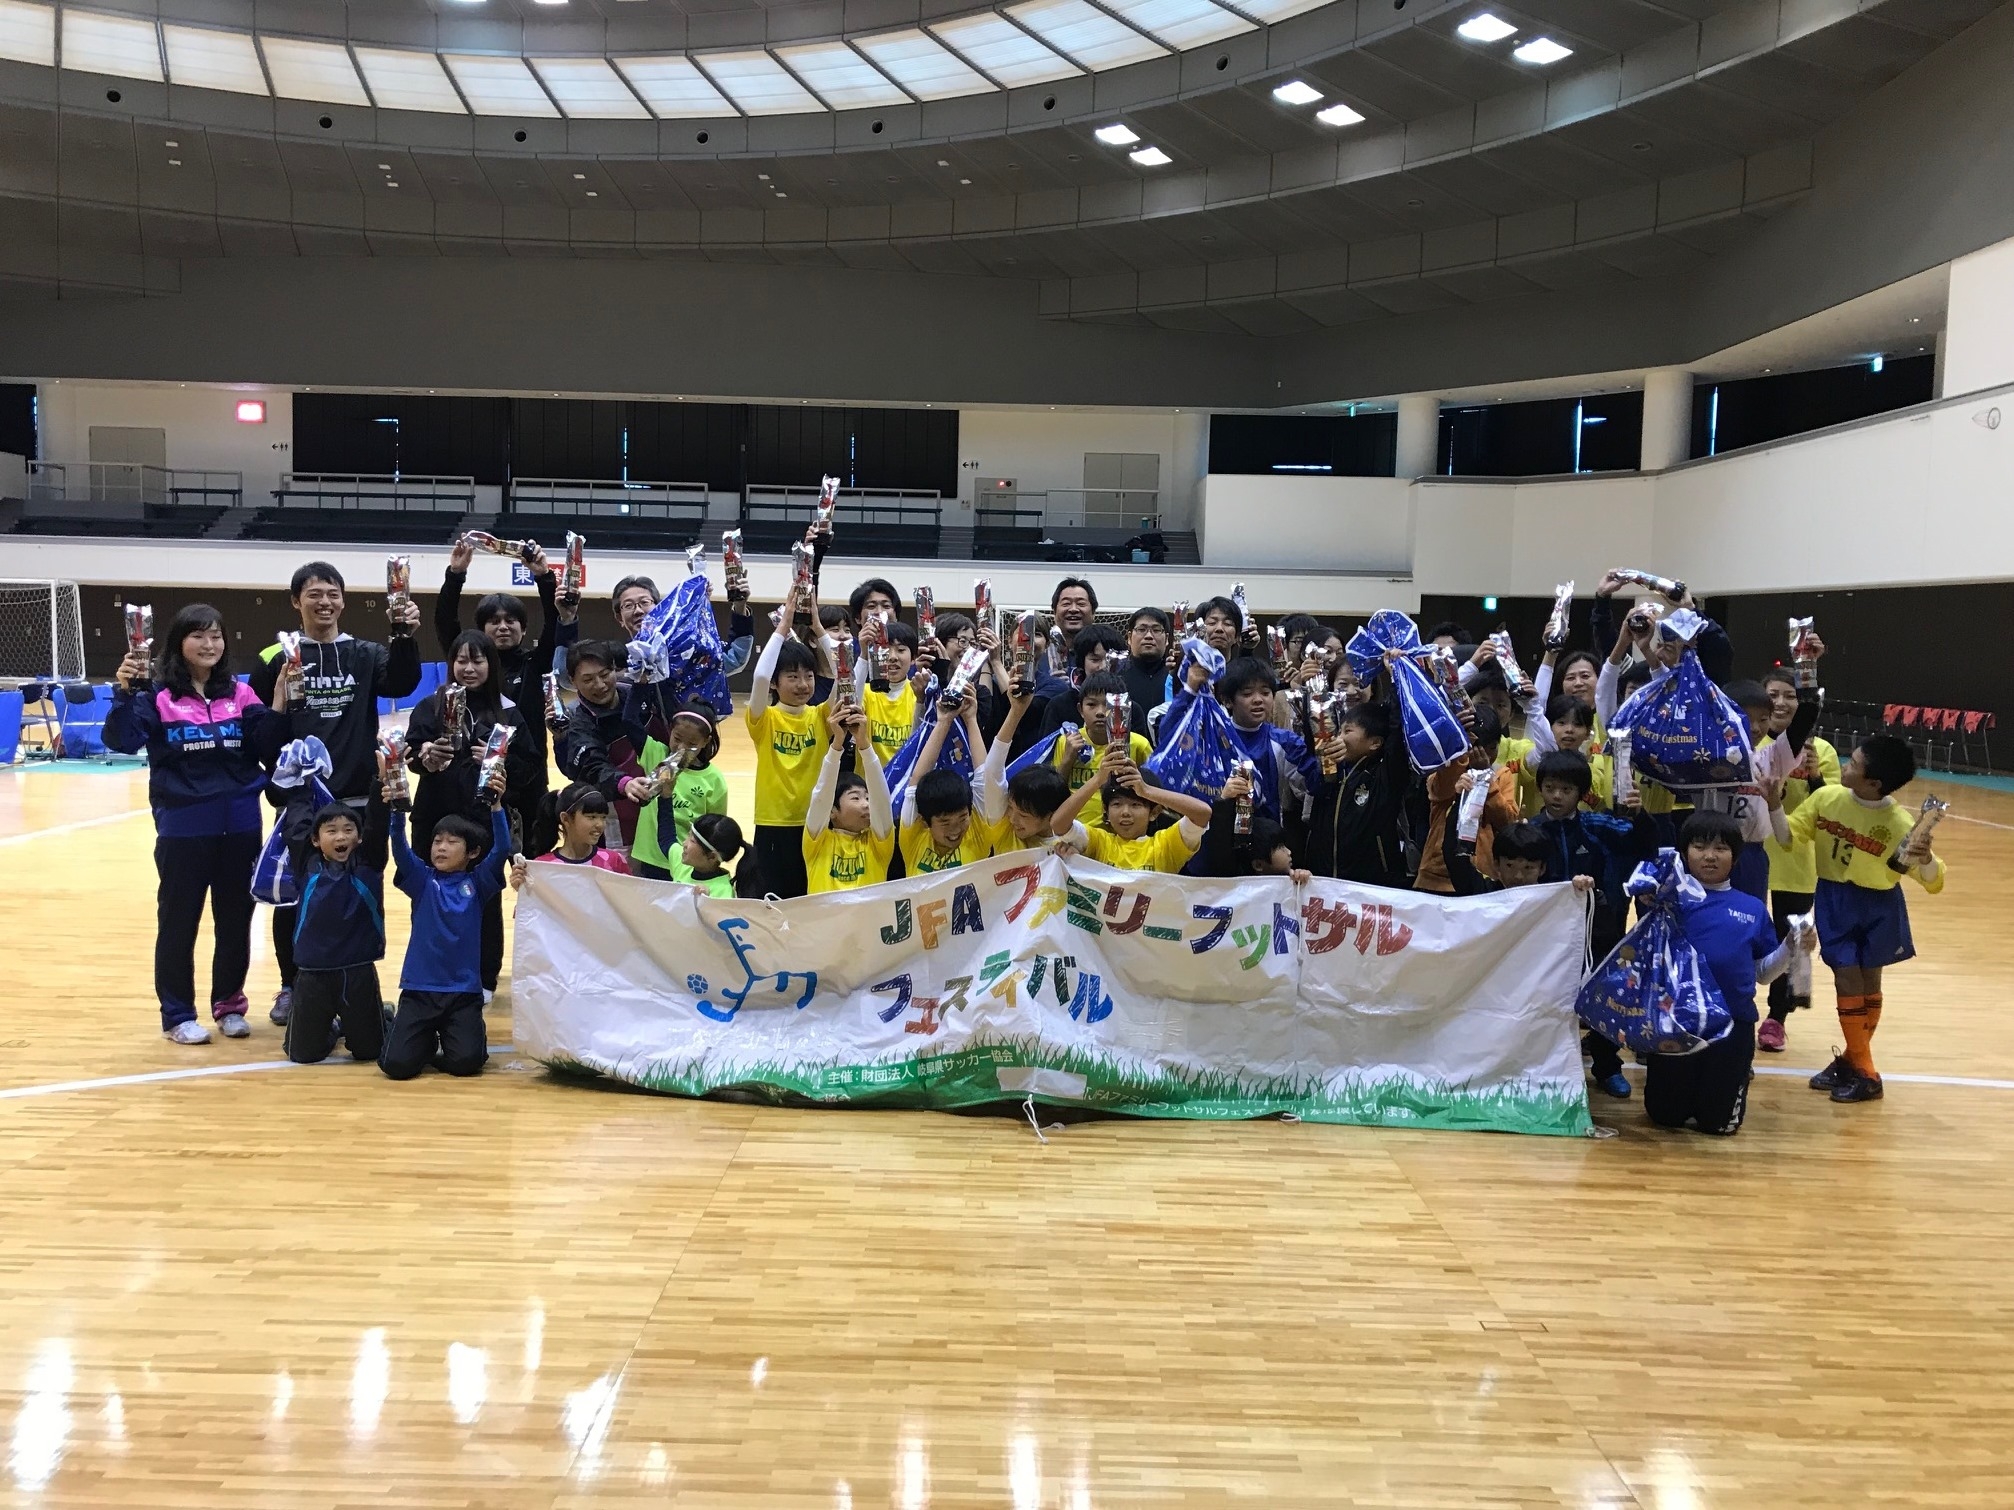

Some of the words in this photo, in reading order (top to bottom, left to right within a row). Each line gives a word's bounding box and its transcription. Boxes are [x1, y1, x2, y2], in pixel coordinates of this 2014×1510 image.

[513, 565, 533, 584] 東
[255, 597, 263, 606] 9
[364, 600, 377, 609] 10
[1727, 795, 1749, 819] 12
[1831, 837, 1853, 866] 13
[881, 882, 985, 950] JFA
[993, 863, 1414, 971] ファミリーフットサル
[871, 949, 1113, 1036] フェスティバル
